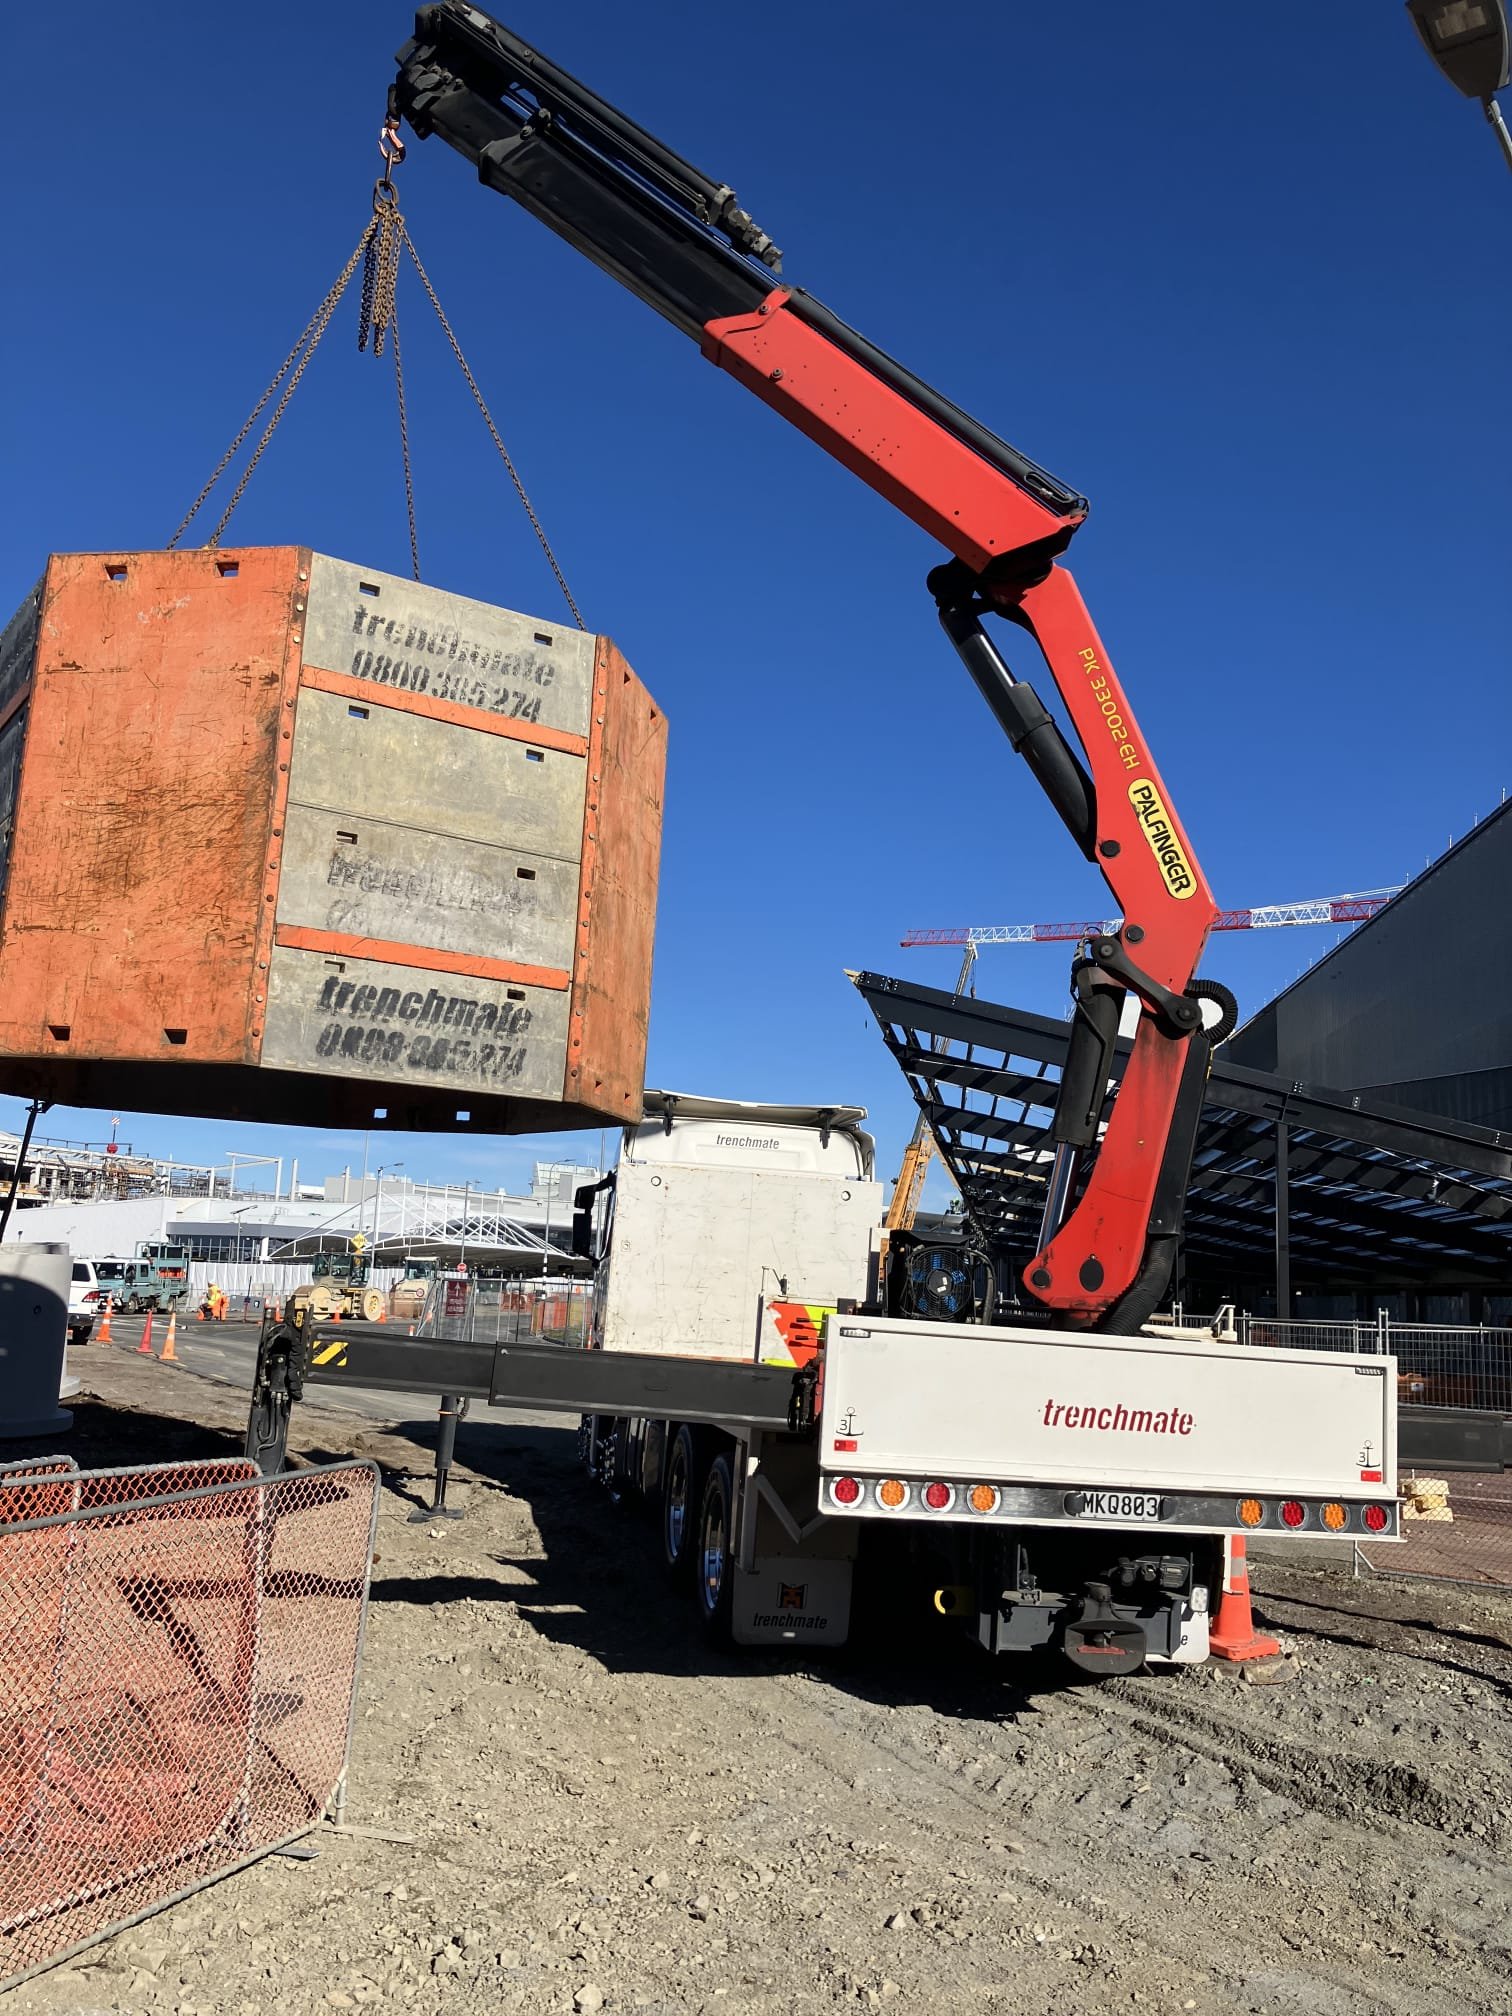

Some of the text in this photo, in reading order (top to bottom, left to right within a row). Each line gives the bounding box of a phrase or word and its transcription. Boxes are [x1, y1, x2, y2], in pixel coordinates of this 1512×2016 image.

[1078, 647, 1101, 675] PK
[351, 649, 431, 693] 0800
[489, 687, 542, 723] 274
[1132, 785, 1191, 894] PALFINGER
[317, 976, 534, 1038] trenchmate
[716, 1134, 780, 1150] trenchmate
[839, 1419, 848, 1431] 3
[1043, 1399, 1194, 1436] trenchmate
[1358, 1451, 1366, 1463] 3
[1082, 1492, 1158, 1517] MKQ803
[753, 1612, 828, 1630] trenchmate
